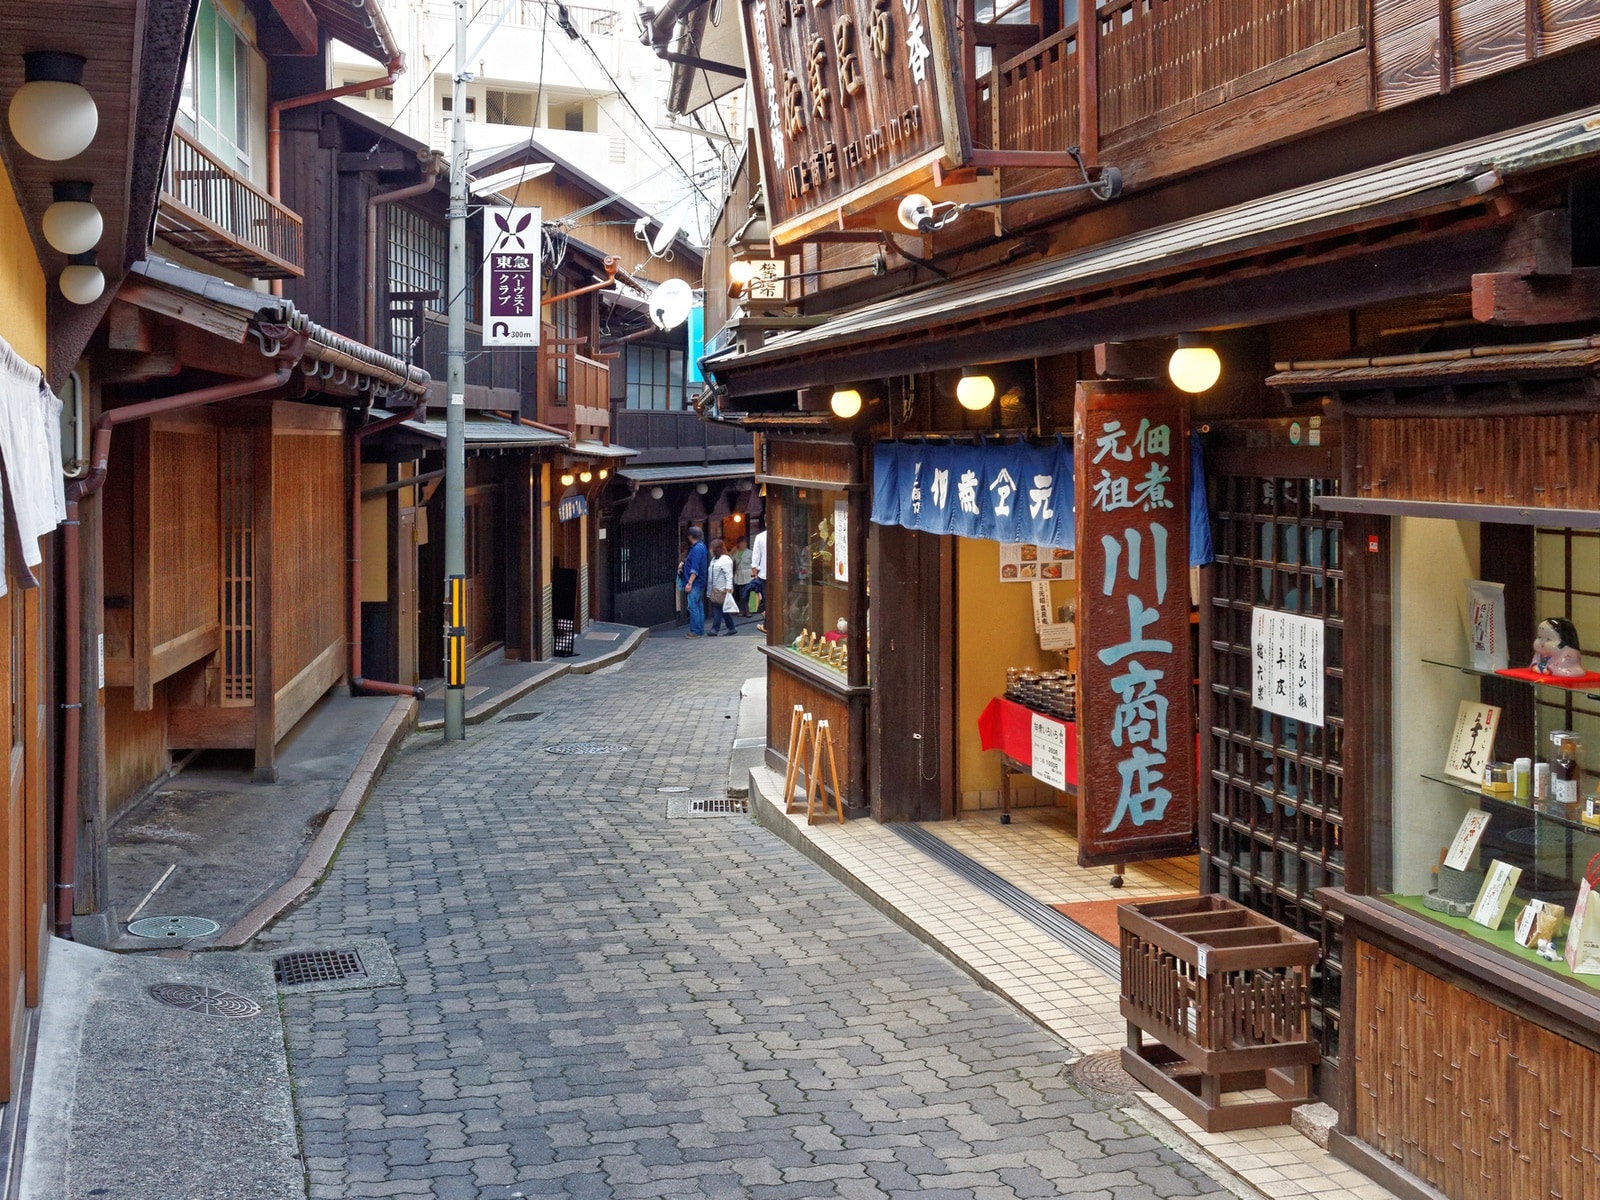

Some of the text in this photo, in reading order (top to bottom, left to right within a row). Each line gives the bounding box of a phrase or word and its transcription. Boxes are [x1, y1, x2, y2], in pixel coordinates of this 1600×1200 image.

[842, 141, 864, 170] TEL
[496, 255, 530, 269] 東急
[498, 274, 511, 305] クラブ
[512, 273, 526, 315] ハーヴェスト
[511, 331, 531, 339] 300m
[1092, 420, 1134, 512] 元祖
[1131, 418, 1174, 512] 佃煮
[1097, 522, 1174, 833] 川上商店
